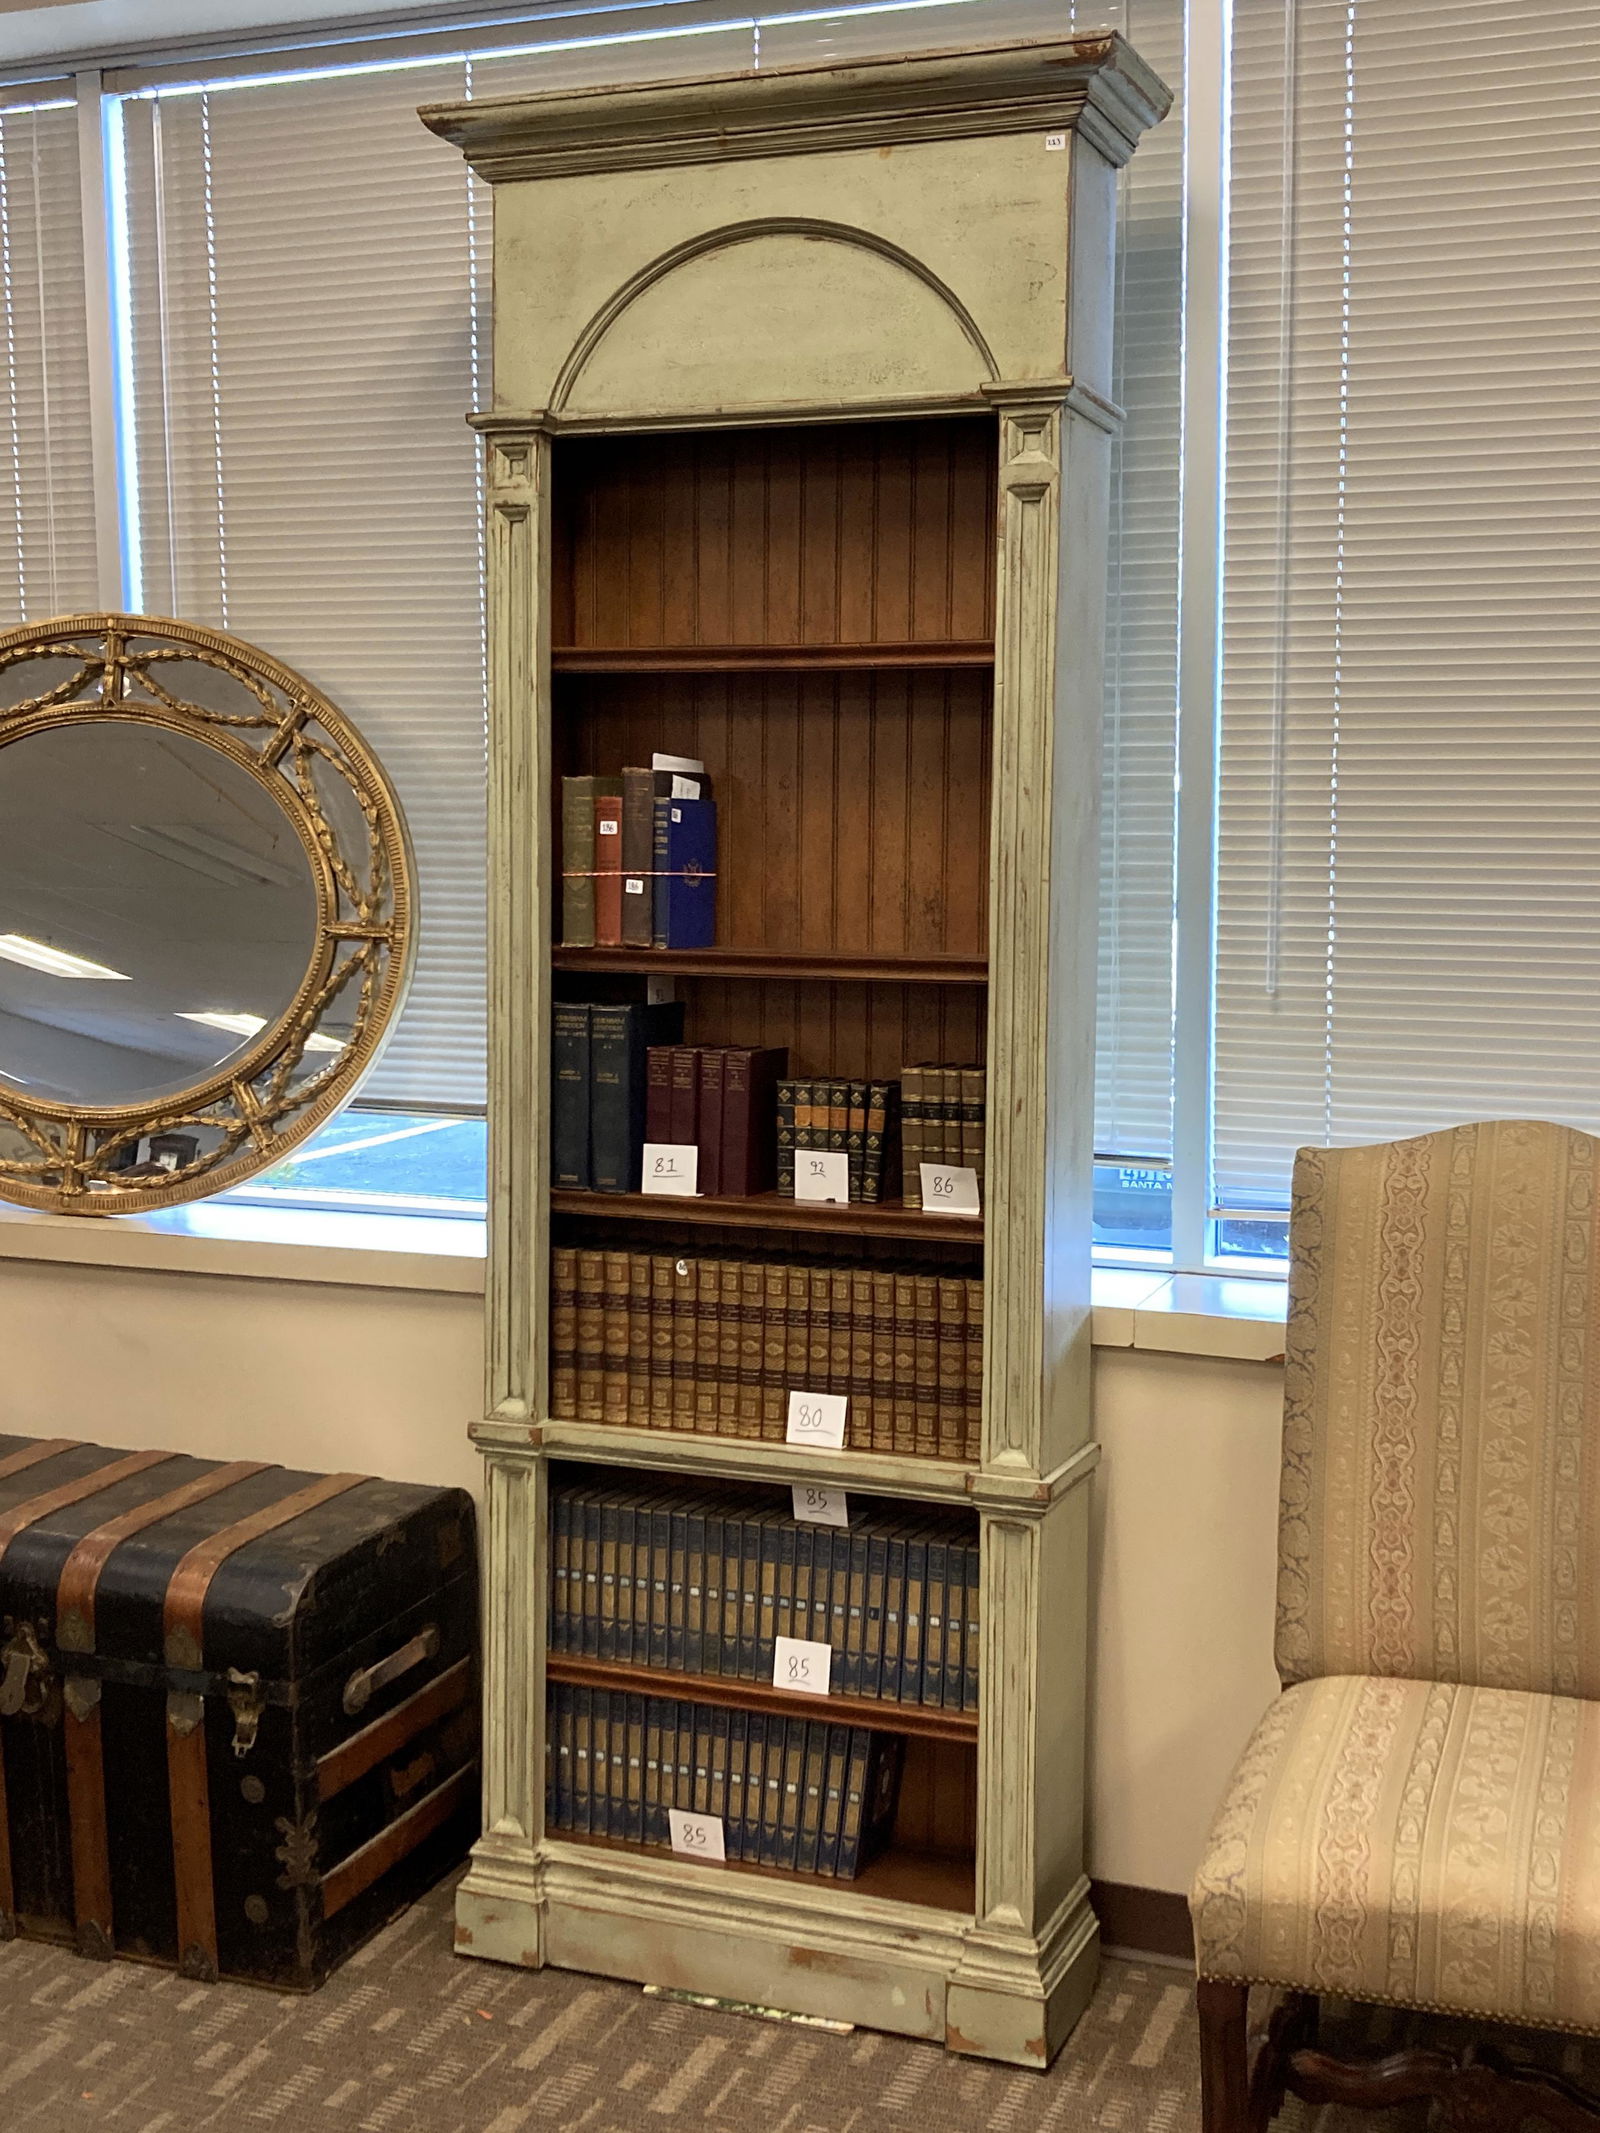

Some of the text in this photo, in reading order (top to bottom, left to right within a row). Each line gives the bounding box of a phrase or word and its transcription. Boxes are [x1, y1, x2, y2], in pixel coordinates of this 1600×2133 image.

[654, 1157, 678, 1173] 81
[810, 1160, 825, 1173] 92
[933, 1176, 954, 1194] 86
[1121, 1180, 1163, 1190] SANTA
[799, 1404, 823, 1428] 80
[806, 1487, 828, 1509] 85
[788, 1655, 809, 1679] 85
[682, 1823, 707, 1845] 85
